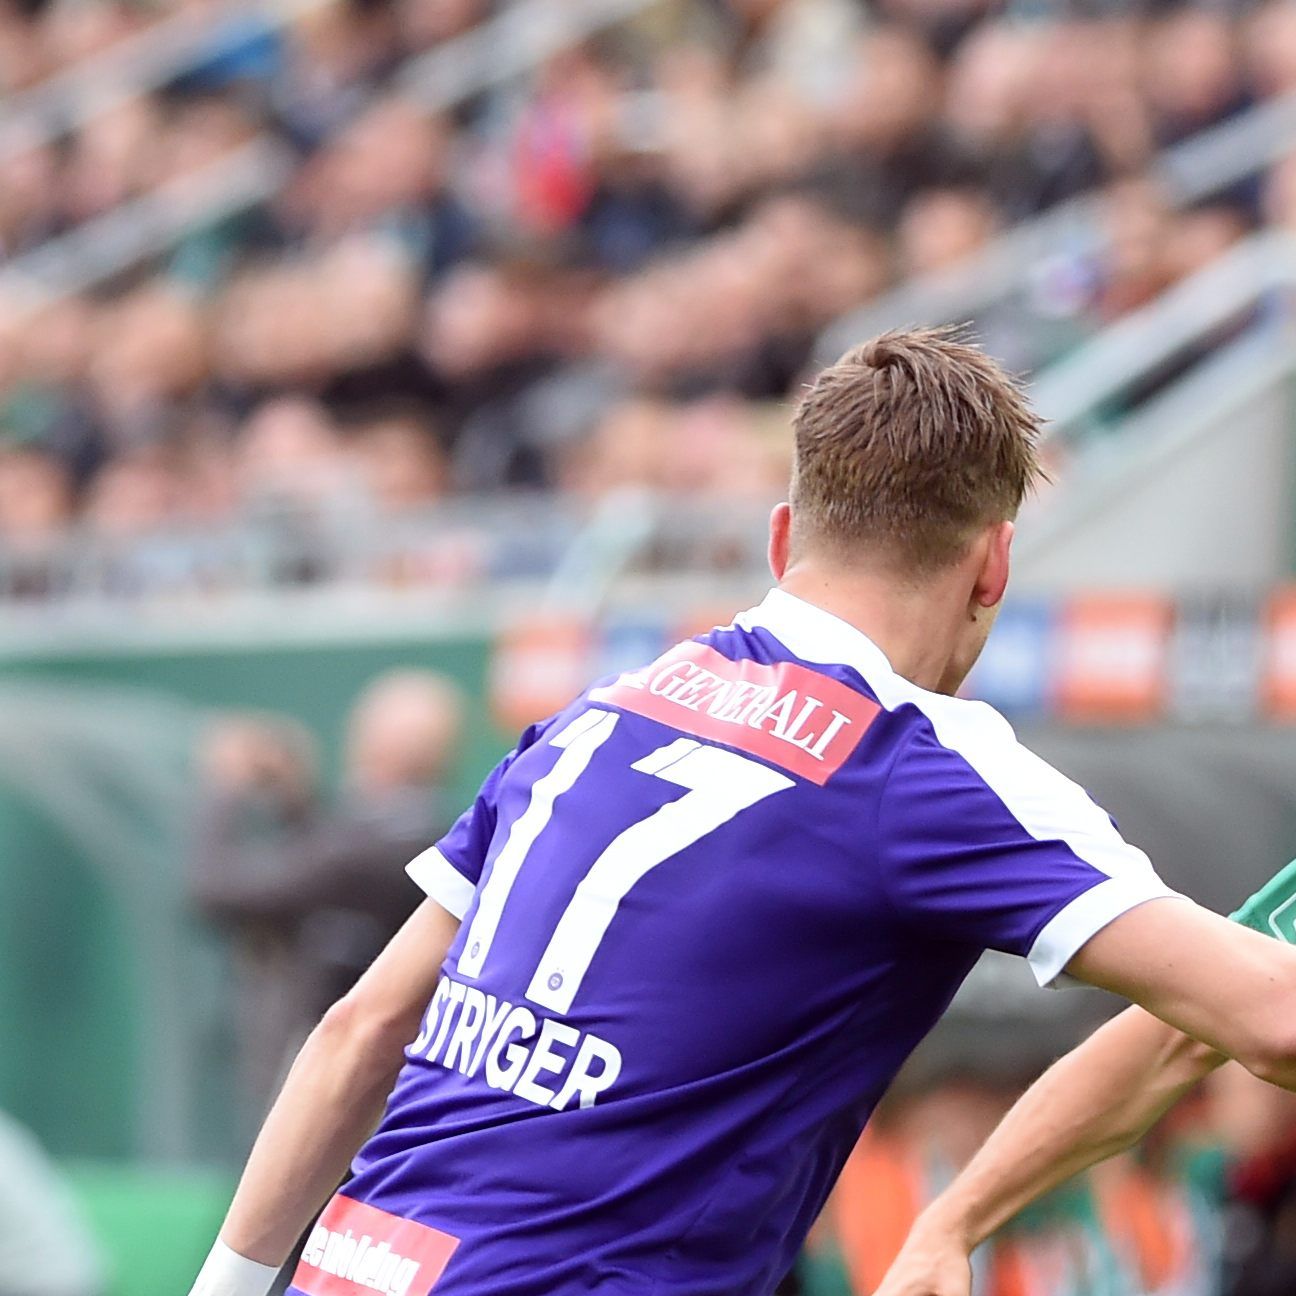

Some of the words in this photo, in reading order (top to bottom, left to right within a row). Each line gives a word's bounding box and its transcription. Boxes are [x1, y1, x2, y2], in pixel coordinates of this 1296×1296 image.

[650, 661, 851, 761] GENERALI
[455, 708, 797, 1015] 17
[409, 976, 623, 1111] STRYGER
